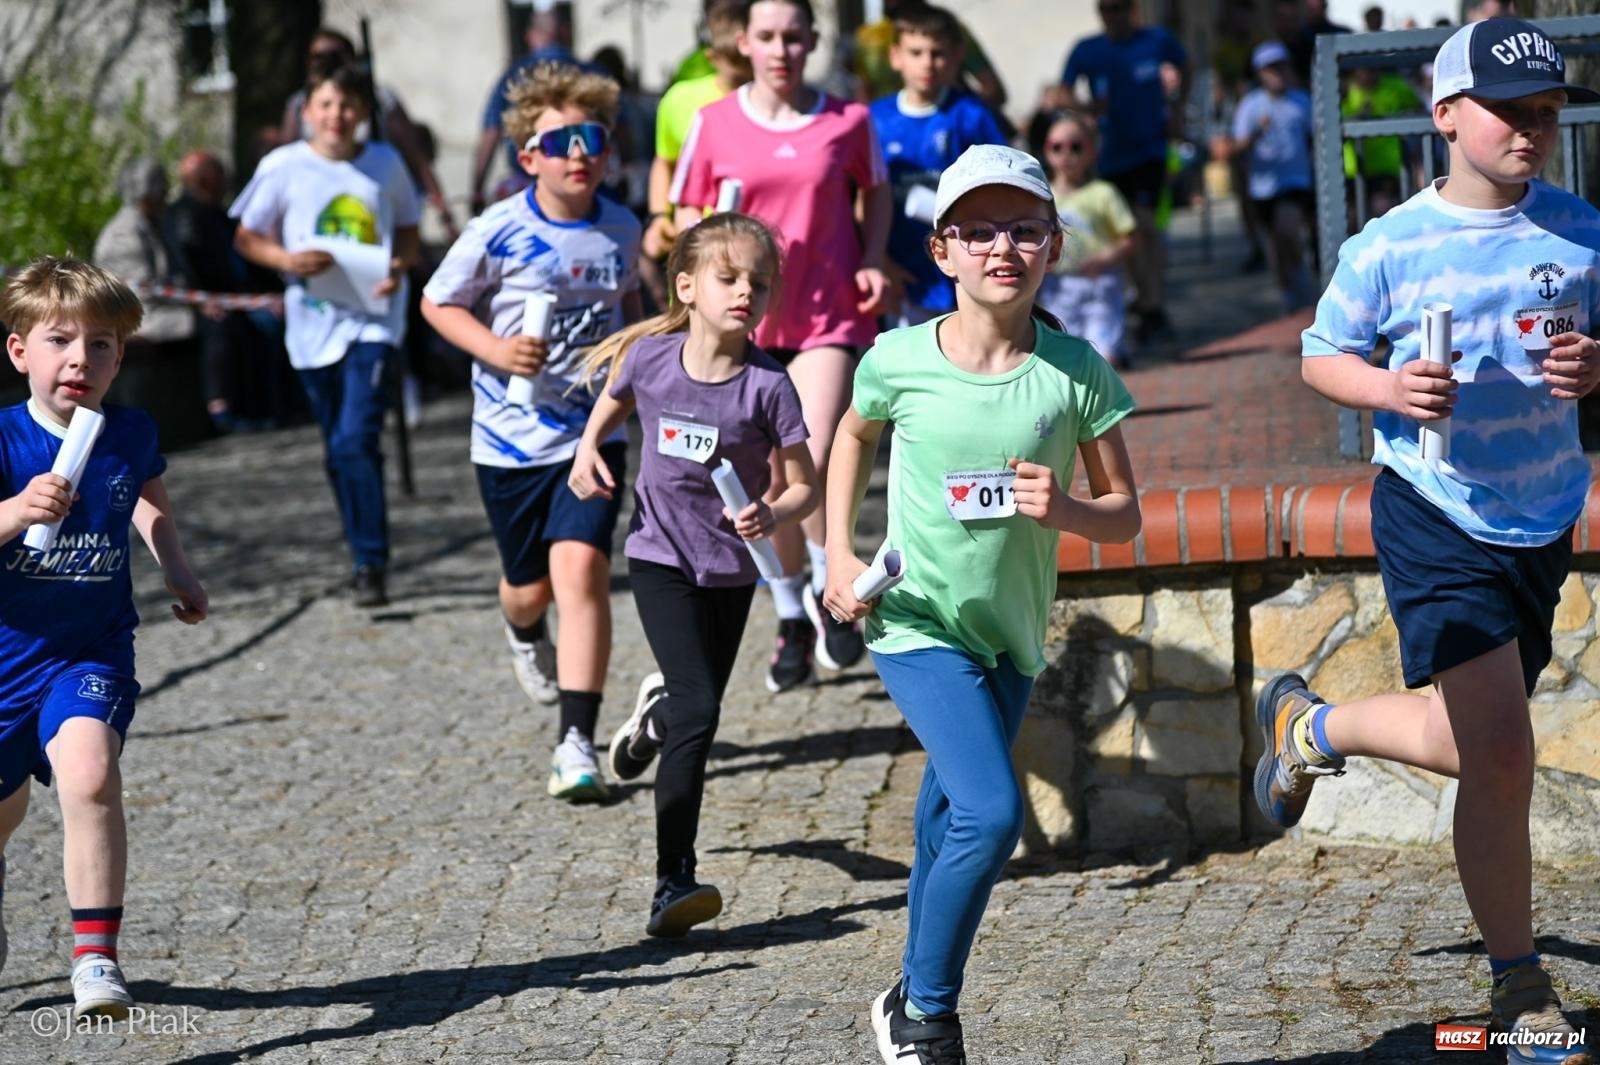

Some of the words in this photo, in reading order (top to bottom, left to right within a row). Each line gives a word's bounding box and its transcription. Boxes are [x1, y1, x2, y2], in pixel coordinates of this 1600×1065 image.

[1491, 32, 1564, 71] CYPRUS
[1543, 315, 1574, 338] 086
[684, 434, 713, 453] 179
